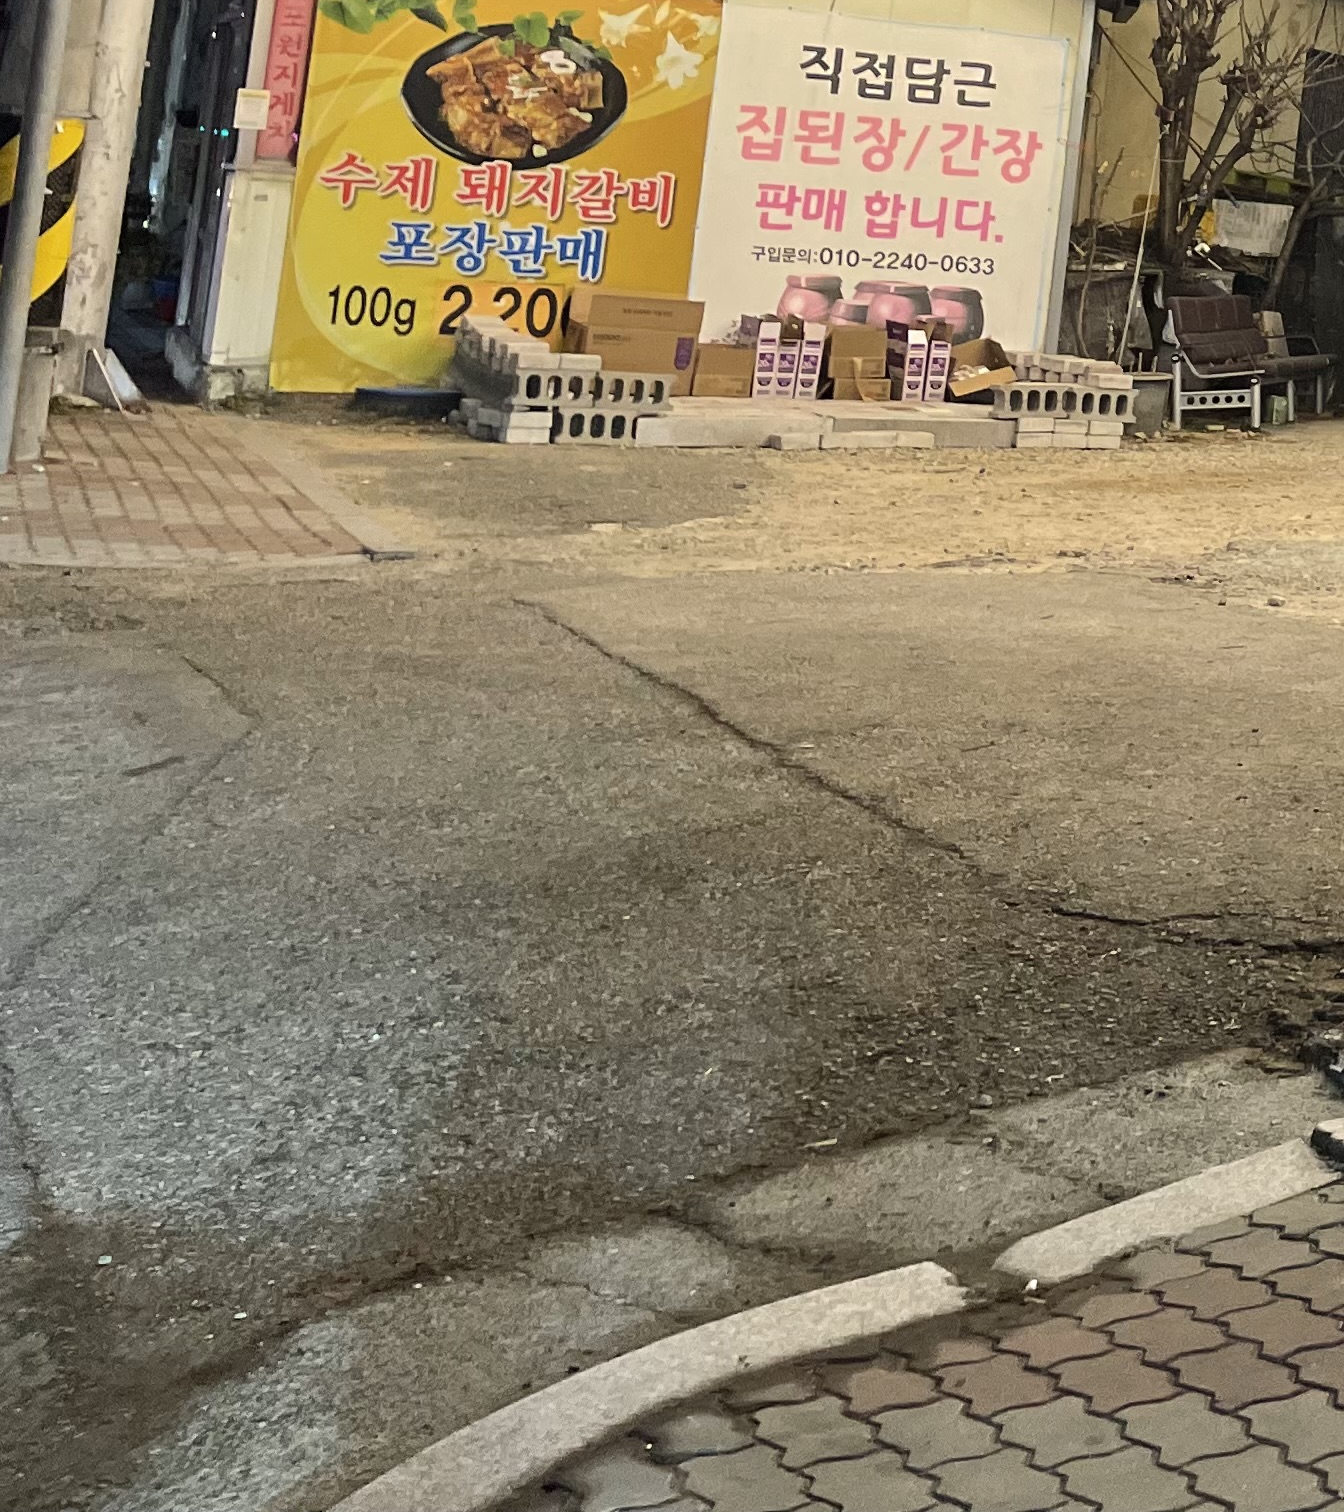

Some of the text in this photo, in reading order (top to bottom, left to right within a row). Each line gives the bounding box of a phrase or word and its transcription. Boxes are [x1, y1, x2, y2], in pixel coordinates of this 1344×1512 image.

[799, 44, 998, 108] 직접담근
[735, 103, 1043, 184] 집된장/간장
[317, 151, 677, 229] 수제 돼지갈비
[755, 183, 1004, 243] 판매 합니다.
[378, 218, 609, 284] 포장판매
[325, 284, 416, 338] 100g
